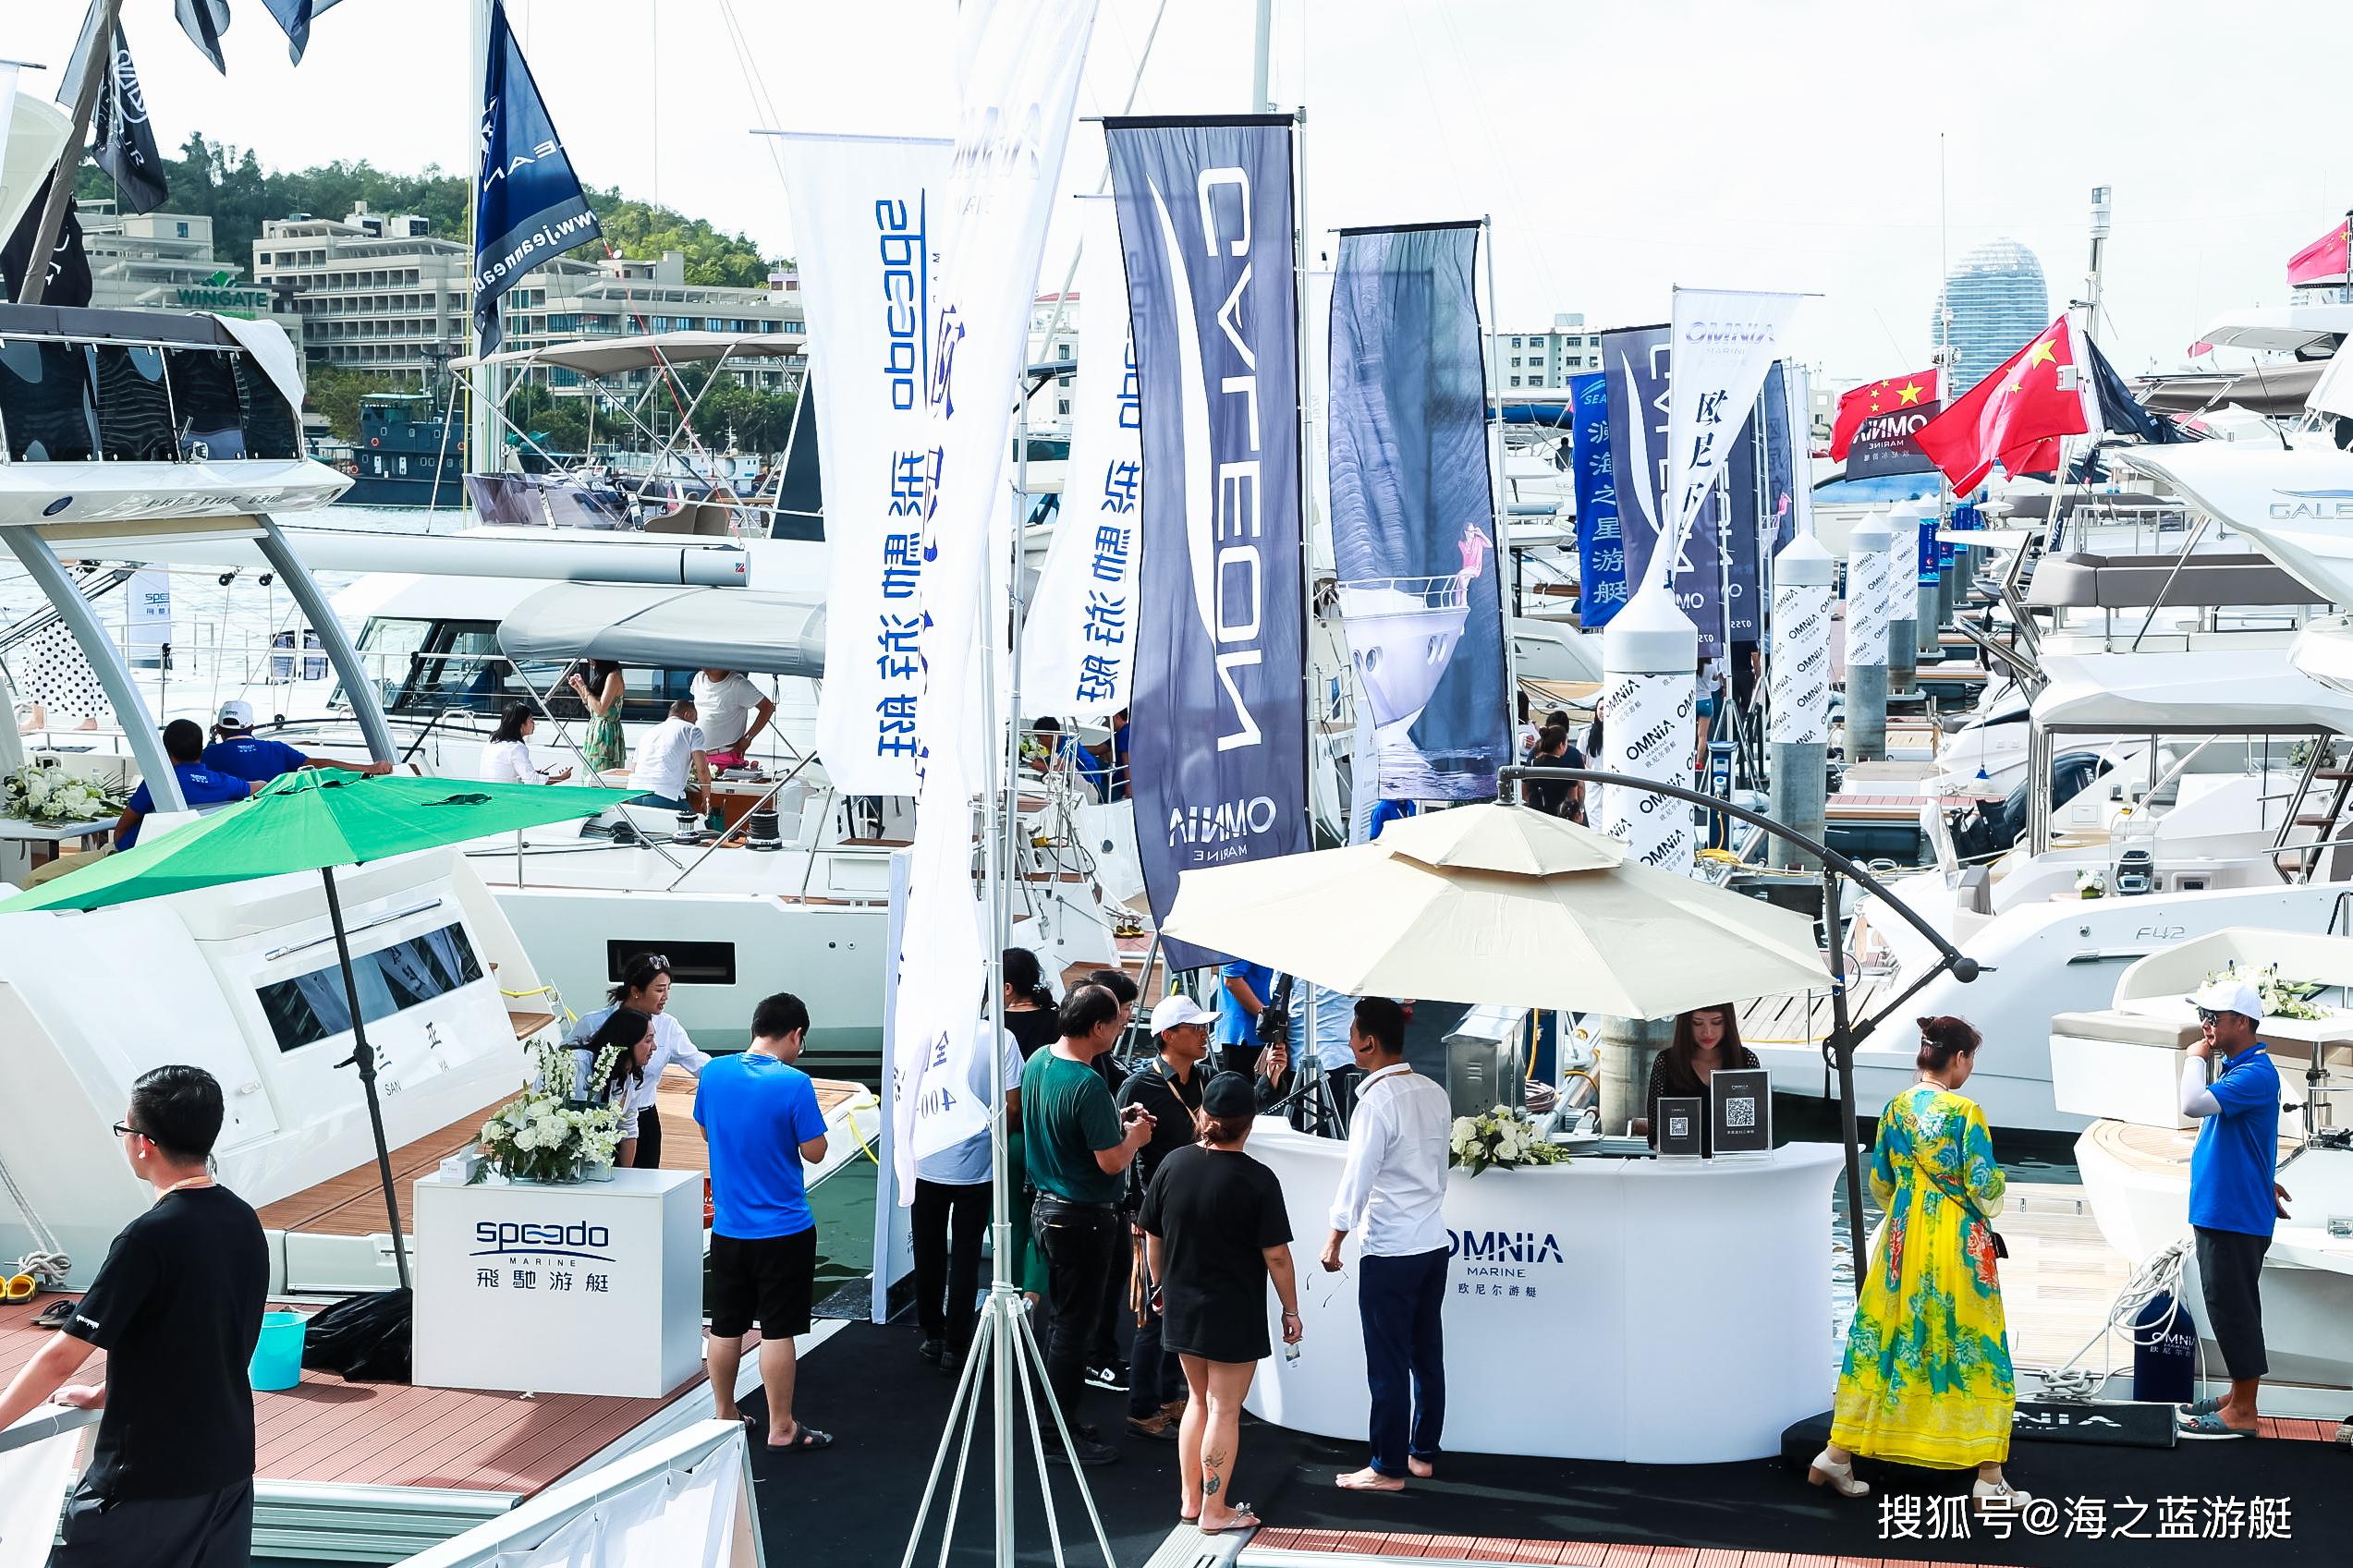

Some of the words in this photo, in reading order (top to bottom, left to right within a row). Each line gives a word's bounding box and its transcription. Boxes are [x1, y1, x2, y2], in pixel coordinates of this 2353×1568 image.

[177, 288, 267, 307] WINGATE
[2270, 503, 2353, 519] GALE
[1788, 614, 1820, 639] OMNIA
[1797, 647, 1825, 673] OMNIA
[1797, 681, 1825, 708] OMNIA
[1627, 719, 1676, 760] OMNIA
[2136, 926, 2186, 940] F42
[384, 1080, 402, 1097] SAN
[476, 1221, 609, 1251] speedo
[510, 1258, 576, 1267] MARINE
[477, 1269, 609, 1292] 飛馳游艇
[1468, 1268, 1526, 1278] MARINE
[1458, 1283, 1537, 1297] 欧尼尔游艇
